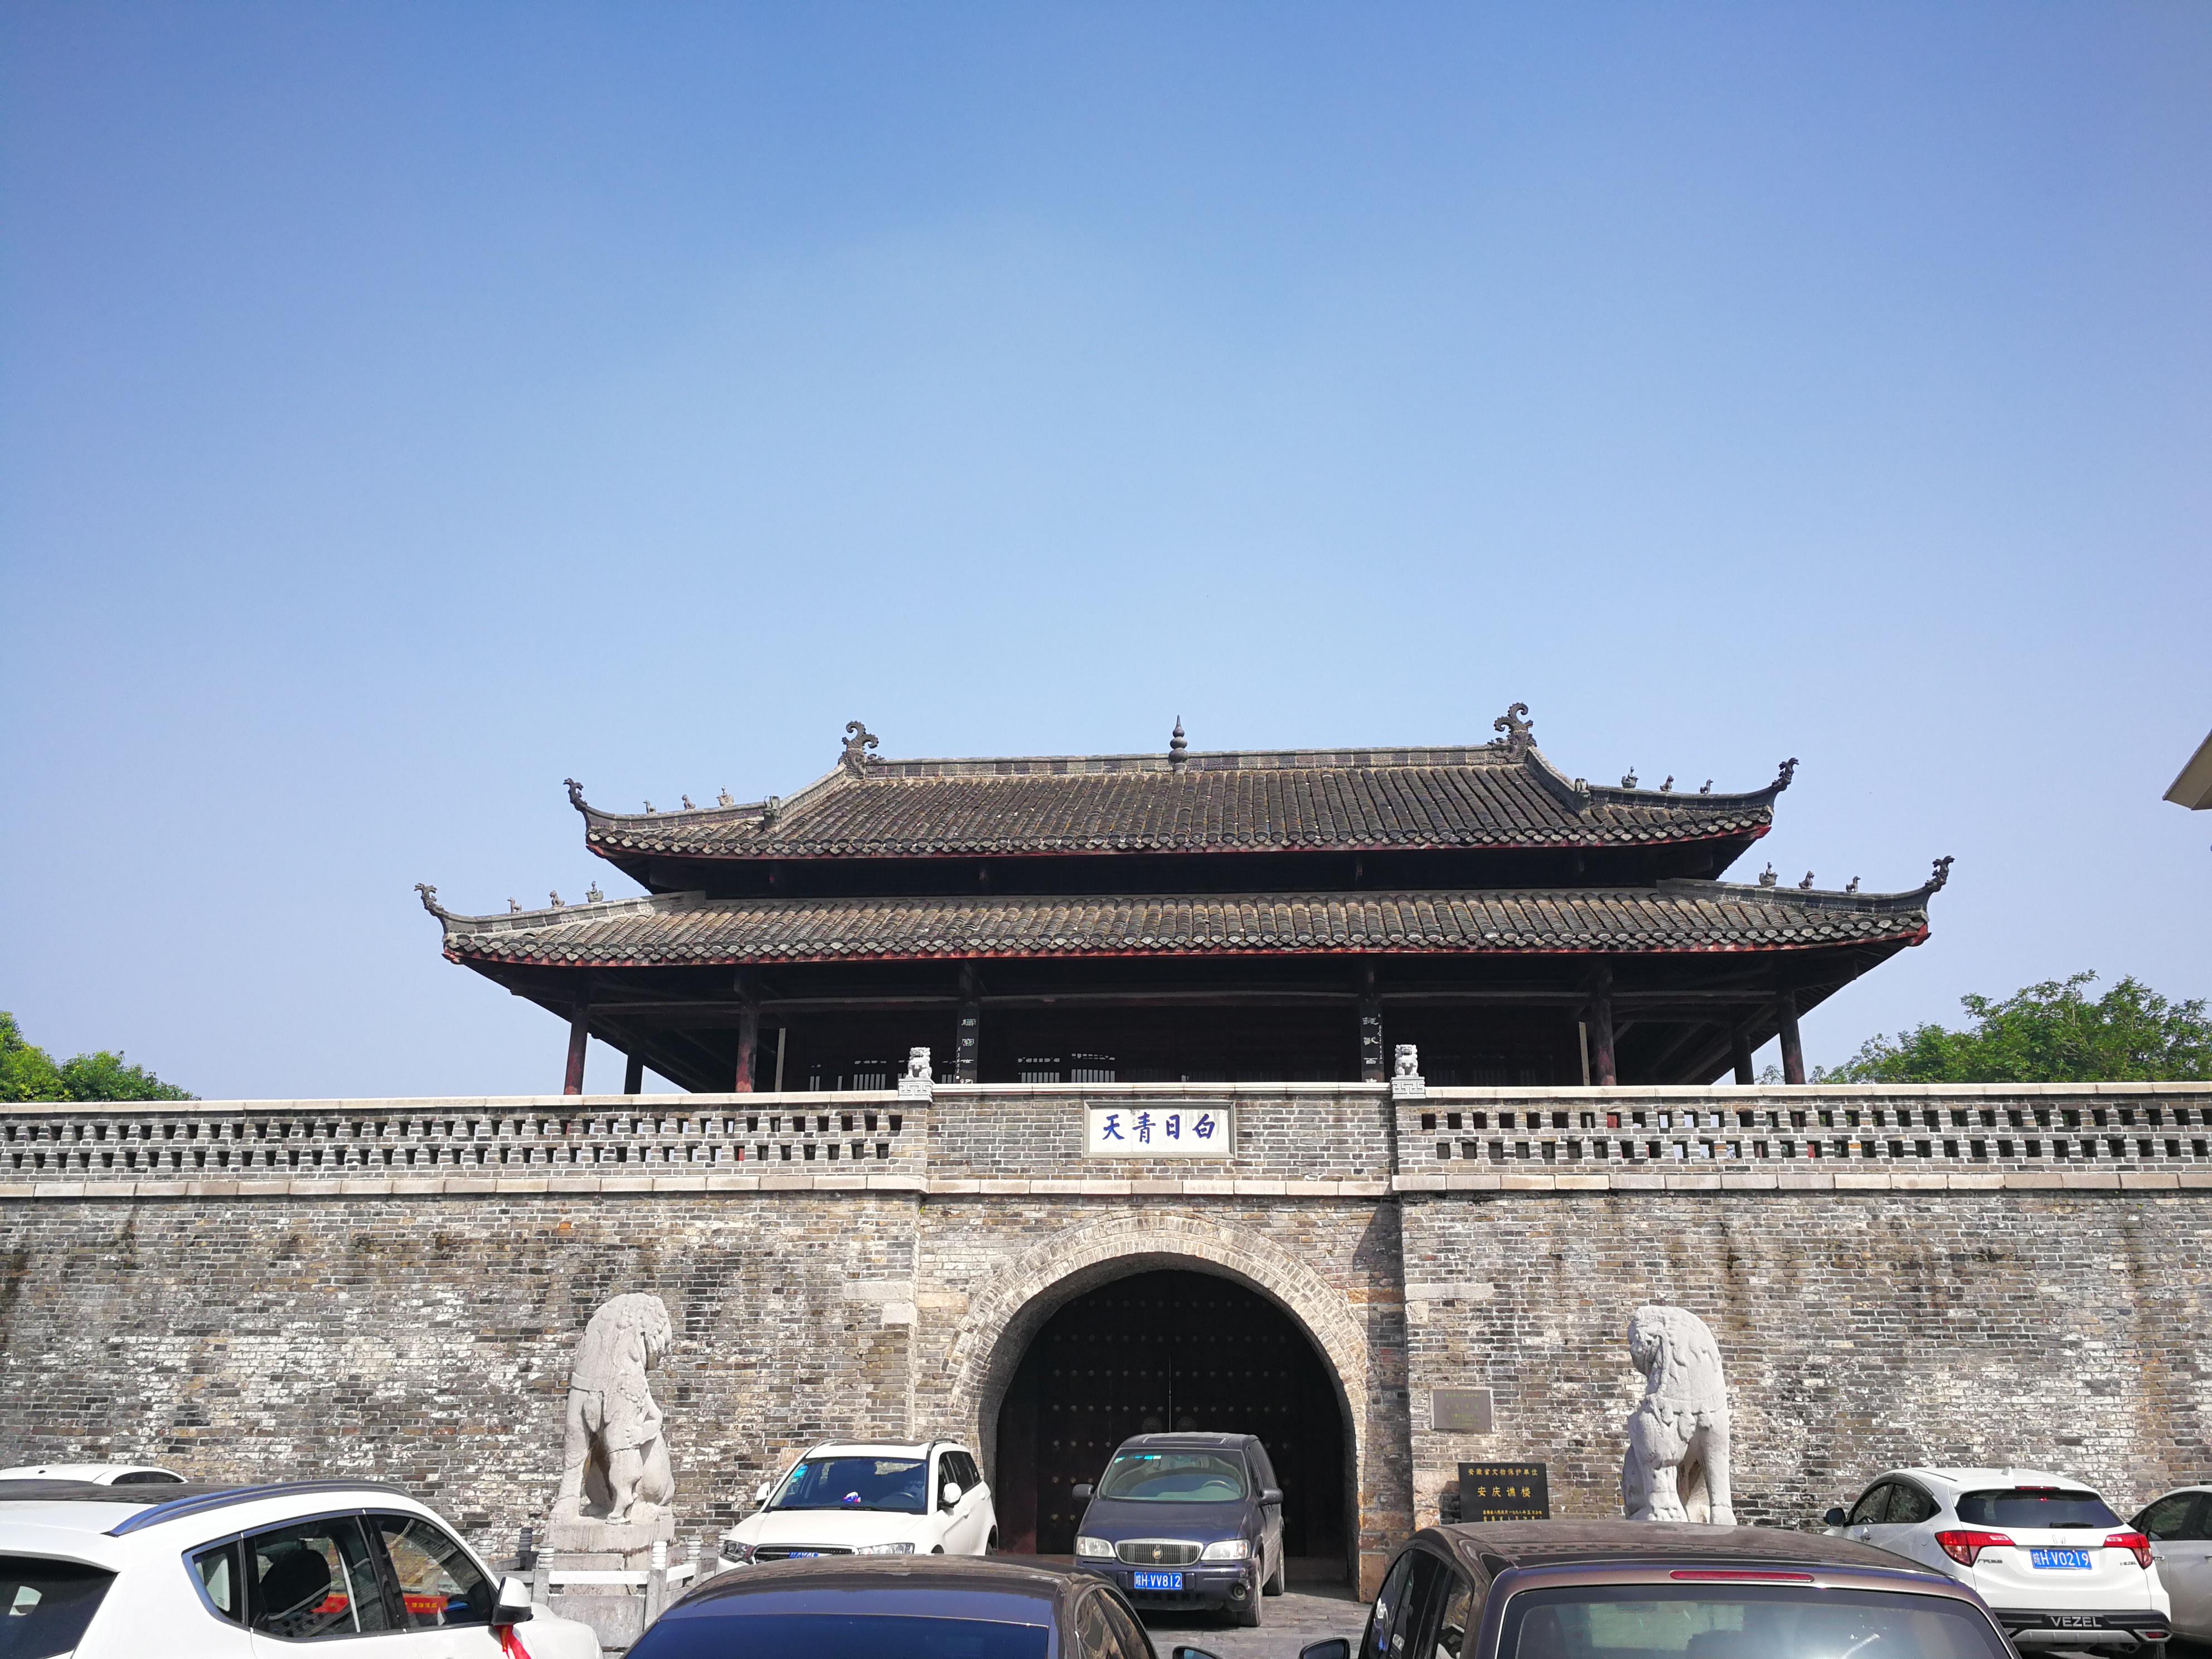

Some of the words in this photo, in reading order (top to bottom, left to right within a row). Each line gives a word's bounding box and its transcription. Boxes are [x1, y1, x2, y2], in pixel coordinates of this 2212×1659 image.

[1477, 1486, 1531, 1497] 安庆谯楼
[2050, 1616, 2102, 1628] VEZEL
